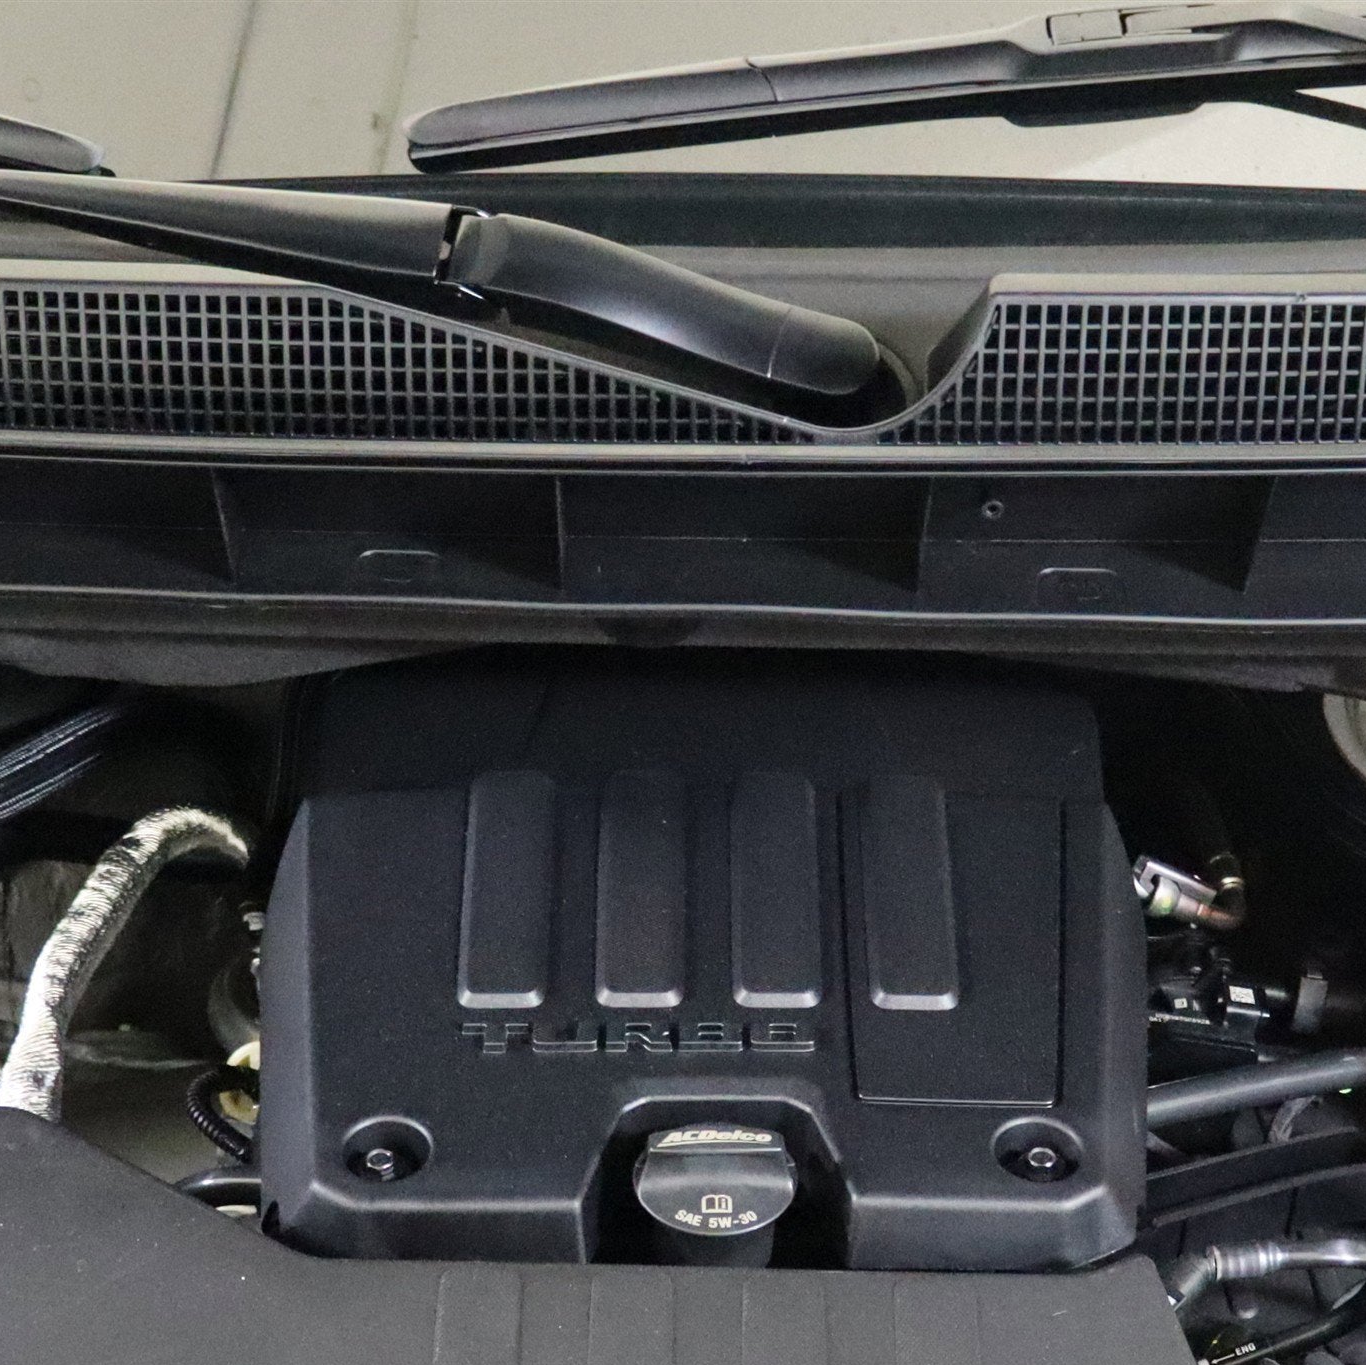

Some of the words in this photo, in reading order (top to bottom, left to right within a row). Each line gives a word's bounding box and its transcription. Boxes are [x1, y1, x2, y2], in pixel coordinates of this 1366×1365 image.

[461, 1022, 816, 1054] TURBO
[659, 1129, 773, 1146] ACDelco
[674, 1209, 703, 1227] SAE
[708, 1210, 758, 1229] 5W-30
